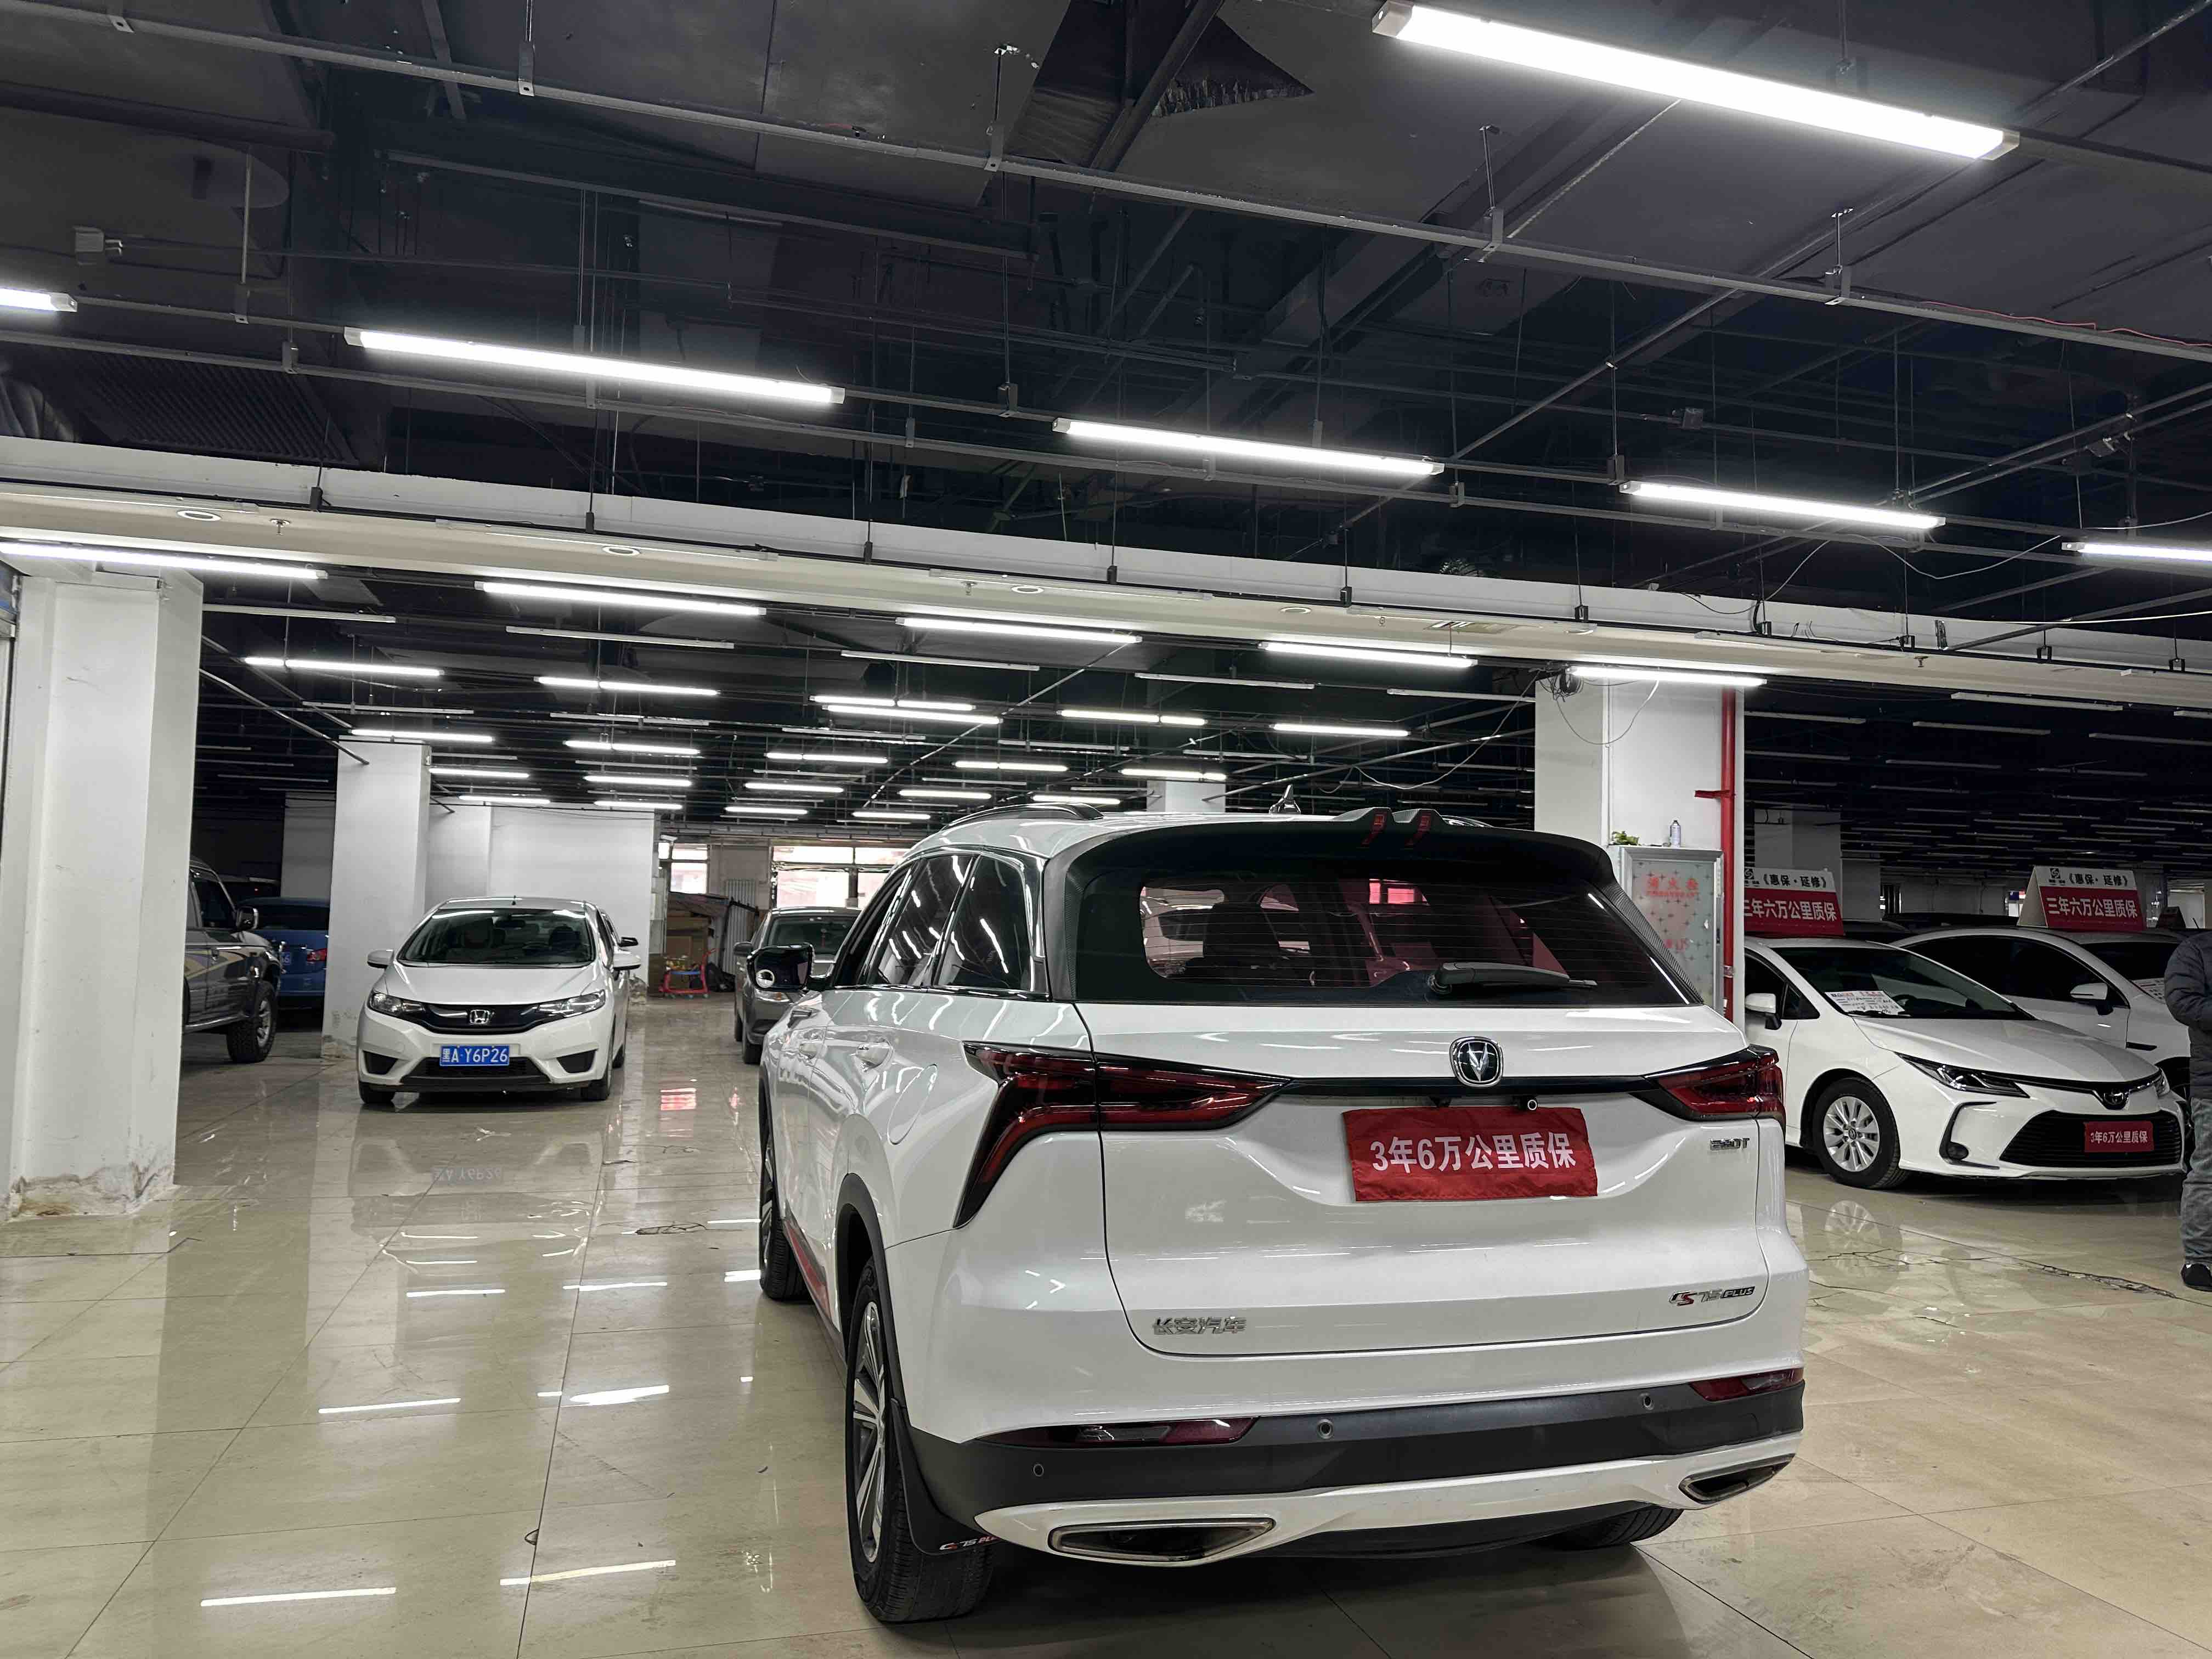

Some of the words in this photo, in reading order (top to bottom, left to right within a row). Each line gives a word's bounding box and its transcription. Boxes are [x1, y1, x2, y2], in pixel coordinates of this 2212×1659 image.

[1744, 898, 1837, 922] 三年六万公里质保
[2046, 896, 2138, 918] 三年六万公里质保
[2090, 1131, 2148, 1144] 3年6万公里质保
[1370, 1131, 1576, 1173] 3年6万公里质保
[1722, 1286, 1755, 1298] PLUS
